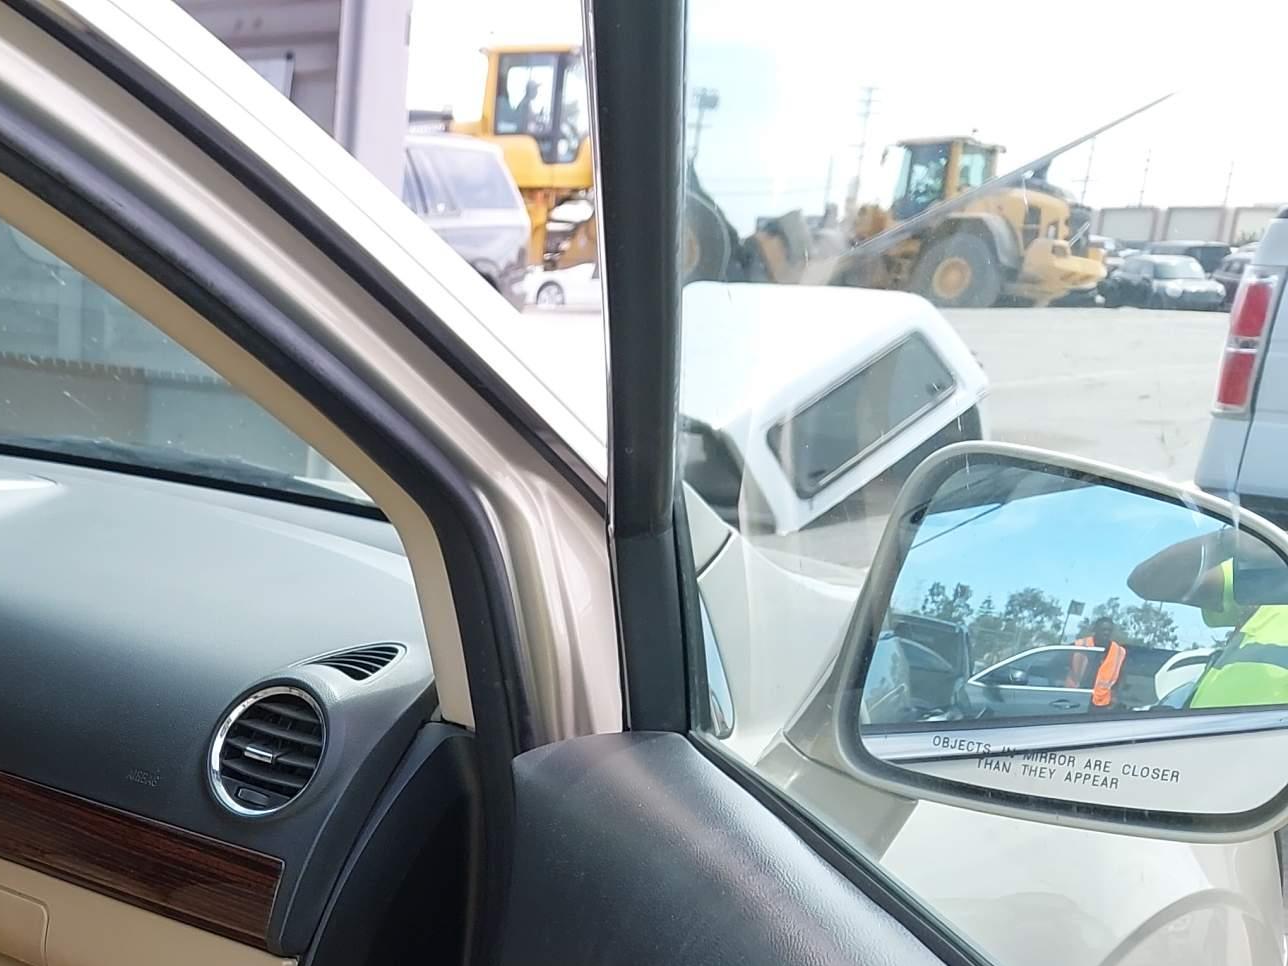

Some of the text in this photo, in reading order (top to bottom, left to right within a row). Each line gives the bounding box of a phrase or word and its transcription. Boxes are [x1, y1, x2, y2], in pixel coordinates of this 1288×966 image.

[932, 735, 1180, 783] OBJECTS IN MIRROR ARE CLOSER
[976, 758, 1119, 789] THAN THEY APPEAR
